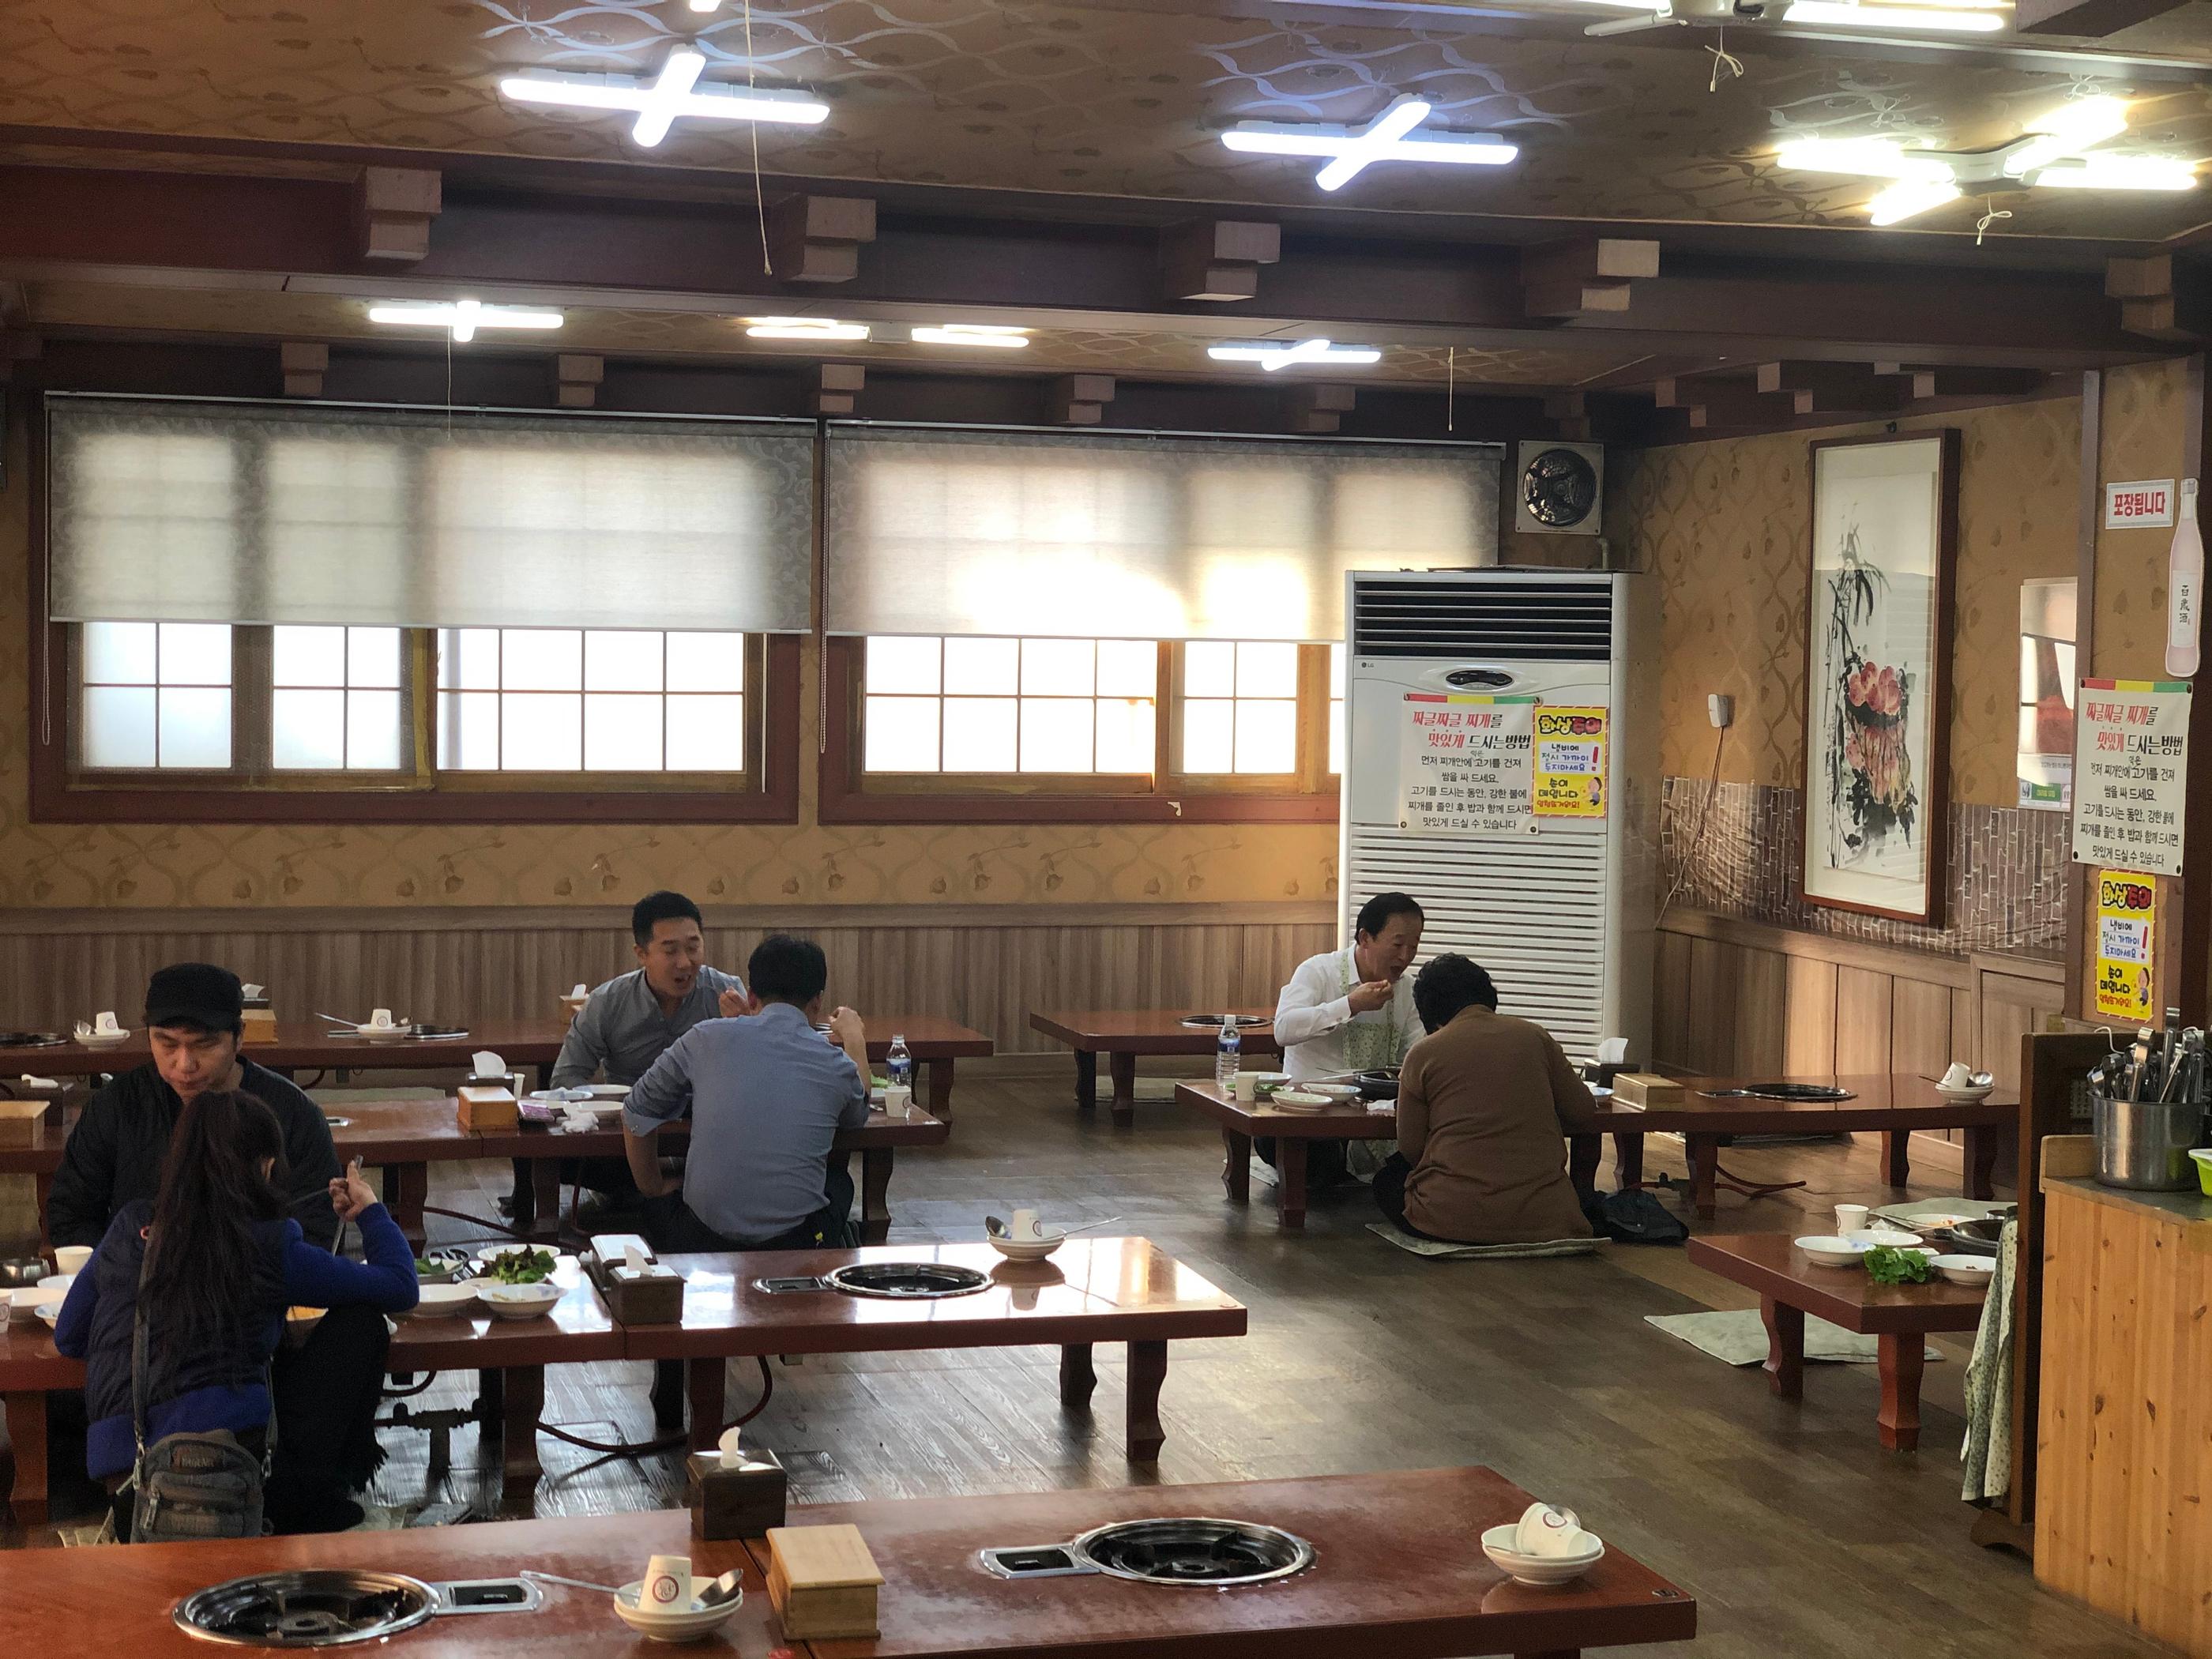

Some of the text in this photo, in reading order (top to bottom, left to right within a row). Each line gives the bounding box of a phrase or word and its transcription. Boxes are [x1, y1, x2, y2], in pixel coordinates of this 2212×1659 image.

[2114, 491, 2165, 516] 포장됩니다
[1413, 711, 1503, 728] 짜글짜글 찌개를
[2086, 702, 2158, 725] 짜글짜글 찌개를
[1428, 732, 1465, 748] 맛있게
[2097, 732, 2124, 752] 맛있게
[1552, 743, 1579, 752] 냄비에
[1421, 755, 1522, 768] 먼저 찌개안에 고기를 건져
[1442, 772, 1458, 781] 쌈을
[1461, 773, 1469, 782] 싸
[2090, 762, 2174, 782] 먼저 찌개안에 고기를 건져
[1411, 786, 1437, 796] 고기를
[1439, 787, 1465, 797] 드시는
[1489, 789, 1507, 799] 강한
[1510, 789, 1527, 799] 불에
[2105, 785, 2117, 798] 쌈을
[2120, 787, 2127, 799] 싸
[1408, 801, 1433, 811] 찌개를
[1456, 803, 1465, 812] 후
[1468, 803, 1484, 813] 밥과
[1488, 804, 1504, 814] 함께
[1507, 805, 1533, 814] 드시면
[2083, 803, 2103, 817] 고기를
[2105, 807, 2124, 820] 드시는
[2147, 811, 2161, 824] 강한
[2163, 812, 2174, 825] 불에
[1423, 817, 1517, 830] 맛있게 드실 수 있습니다
[2080, 823, 2101, 837] 찌개를
[2117, 828, 2124, 841] 후
[2127, 830, 2142, 843] 밥과
[2145, 830, 2158, 844] 함께
[2158, 833, 2179, 847] 드시면
[2092, 845, 2165, 867] 맛있게 드실 수 있습니다
[2110, 920, 2133, 931] 냄비에
[2118, 935, 2139, 946] 가까이
[2105, 945, 2136, 959] 두지마세요
